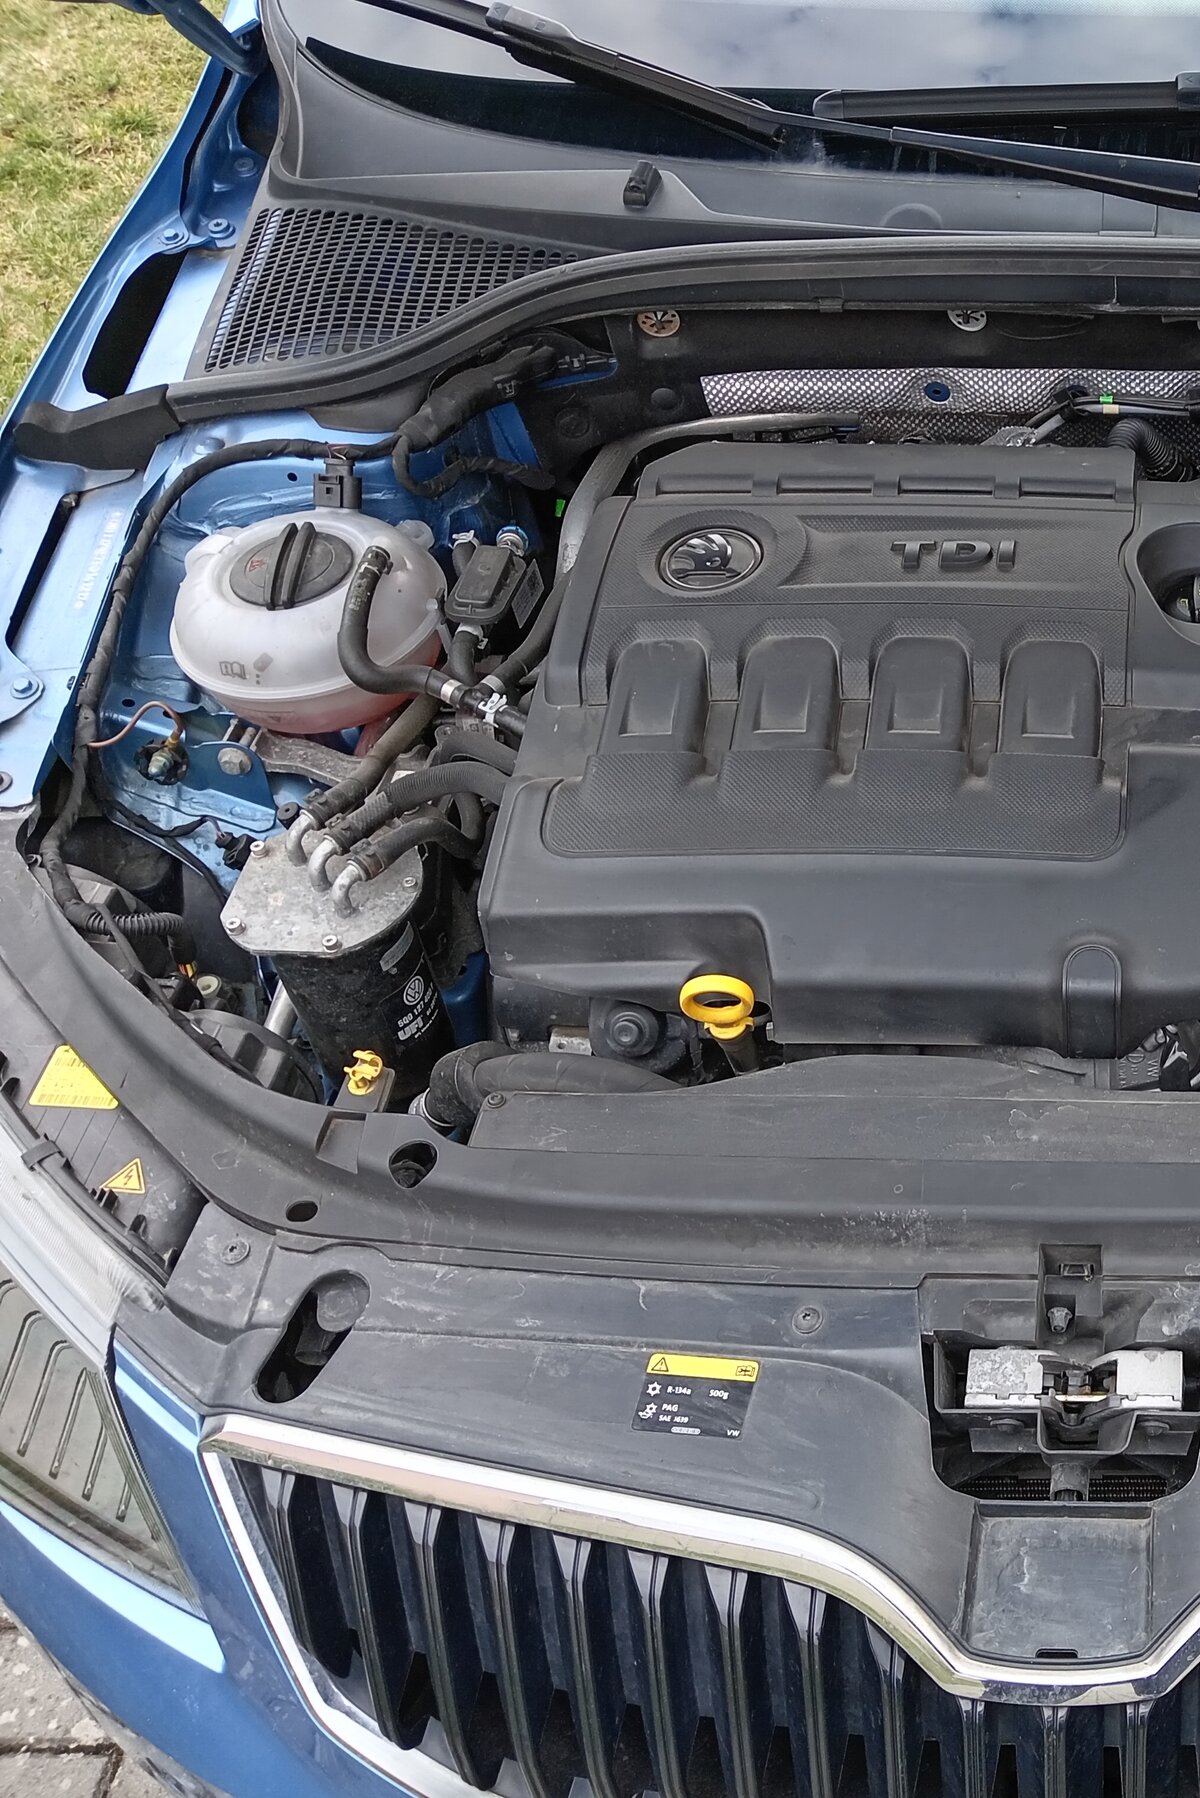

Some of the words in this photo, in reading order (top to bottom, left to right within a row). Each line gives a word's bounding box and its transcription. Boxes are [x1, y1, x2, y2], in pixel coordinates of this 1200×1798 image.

[890, 540, 1016, 570] TDI
[666, 1385, 692, 1395] R-134a
[708, 1389, 729, 1400] 500g
[662, 1404, 679, 1412] PAG
